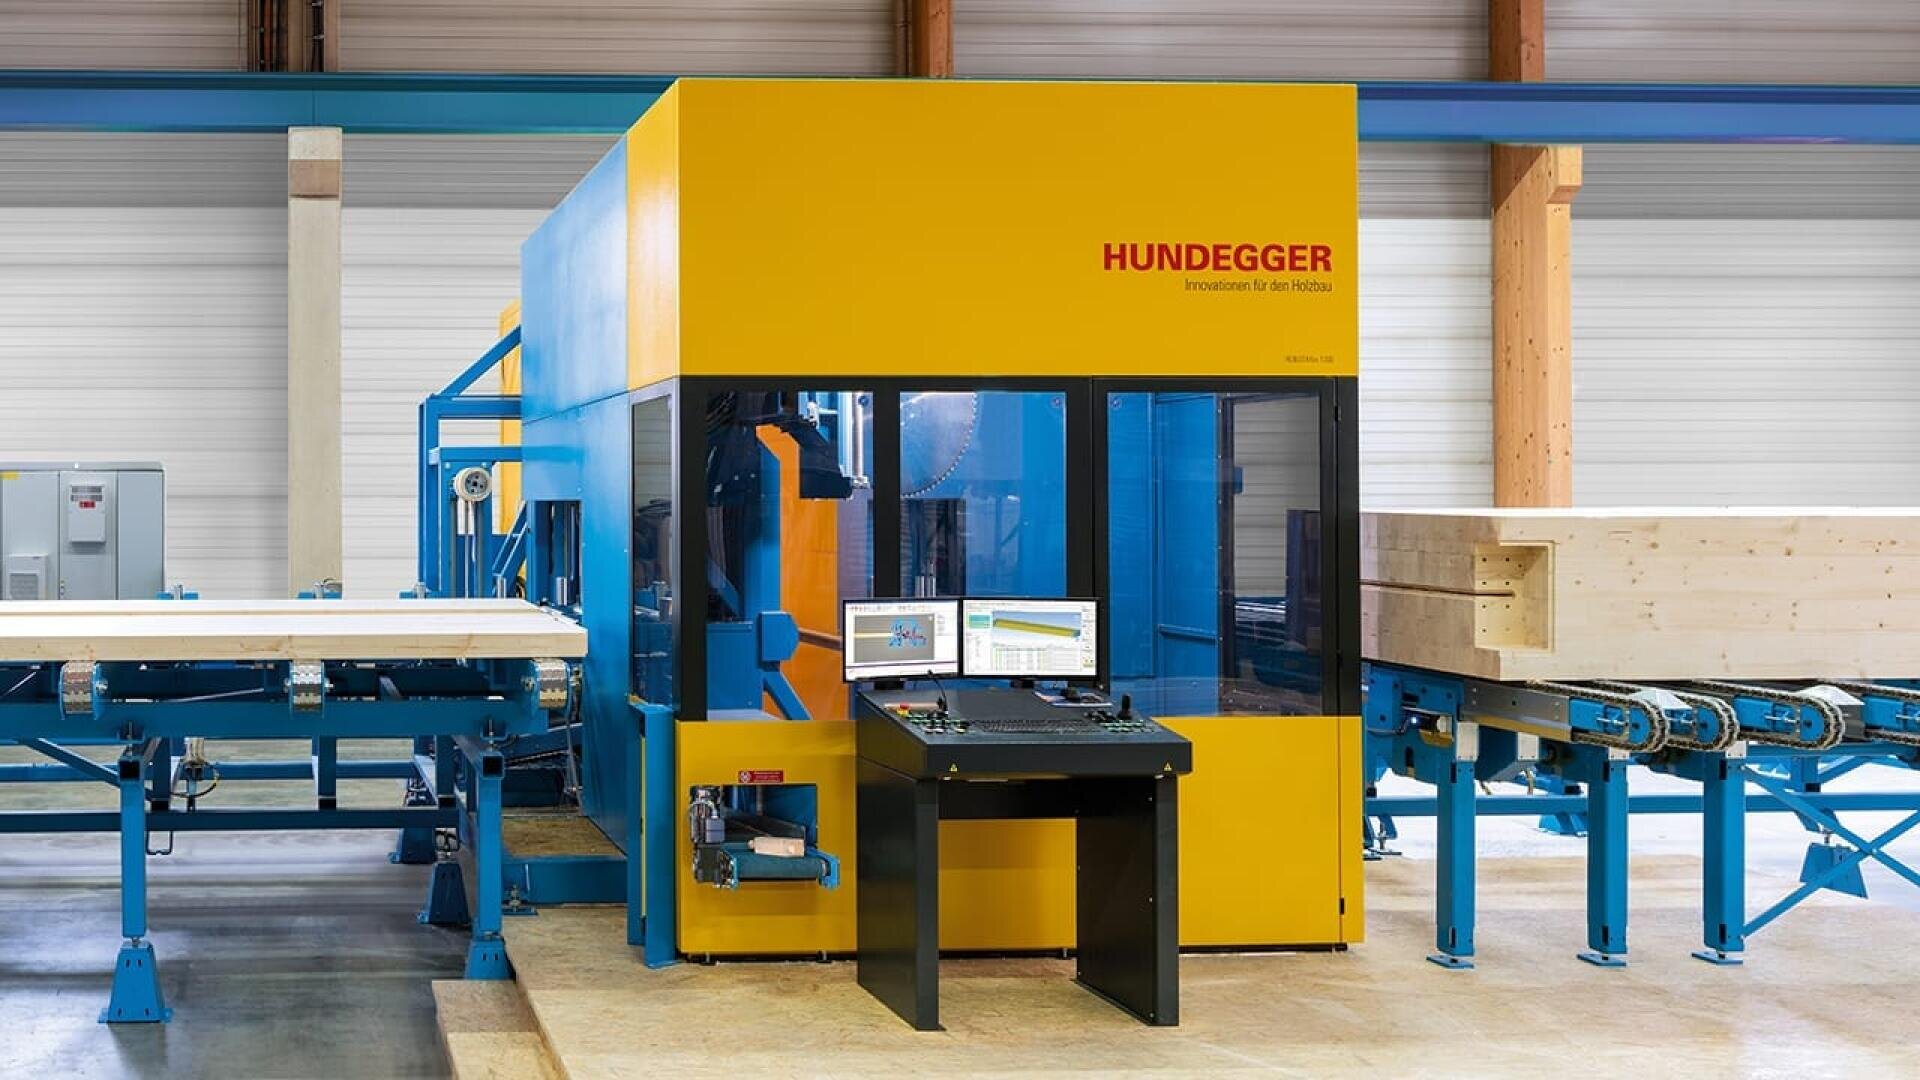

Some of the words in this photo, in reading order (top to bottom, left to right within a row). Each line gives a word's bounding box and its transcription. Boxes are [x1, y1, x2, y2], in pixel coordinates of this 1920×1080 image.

[1103, 243, 1332, 272] HUNDEGGER
[1184, 279, 1250, 291] Innovationen
[1253, 279, 1267, 291] für
[1270, 280, 1289, 292] den
[1292, 280, 1333, 292] Holzbau
